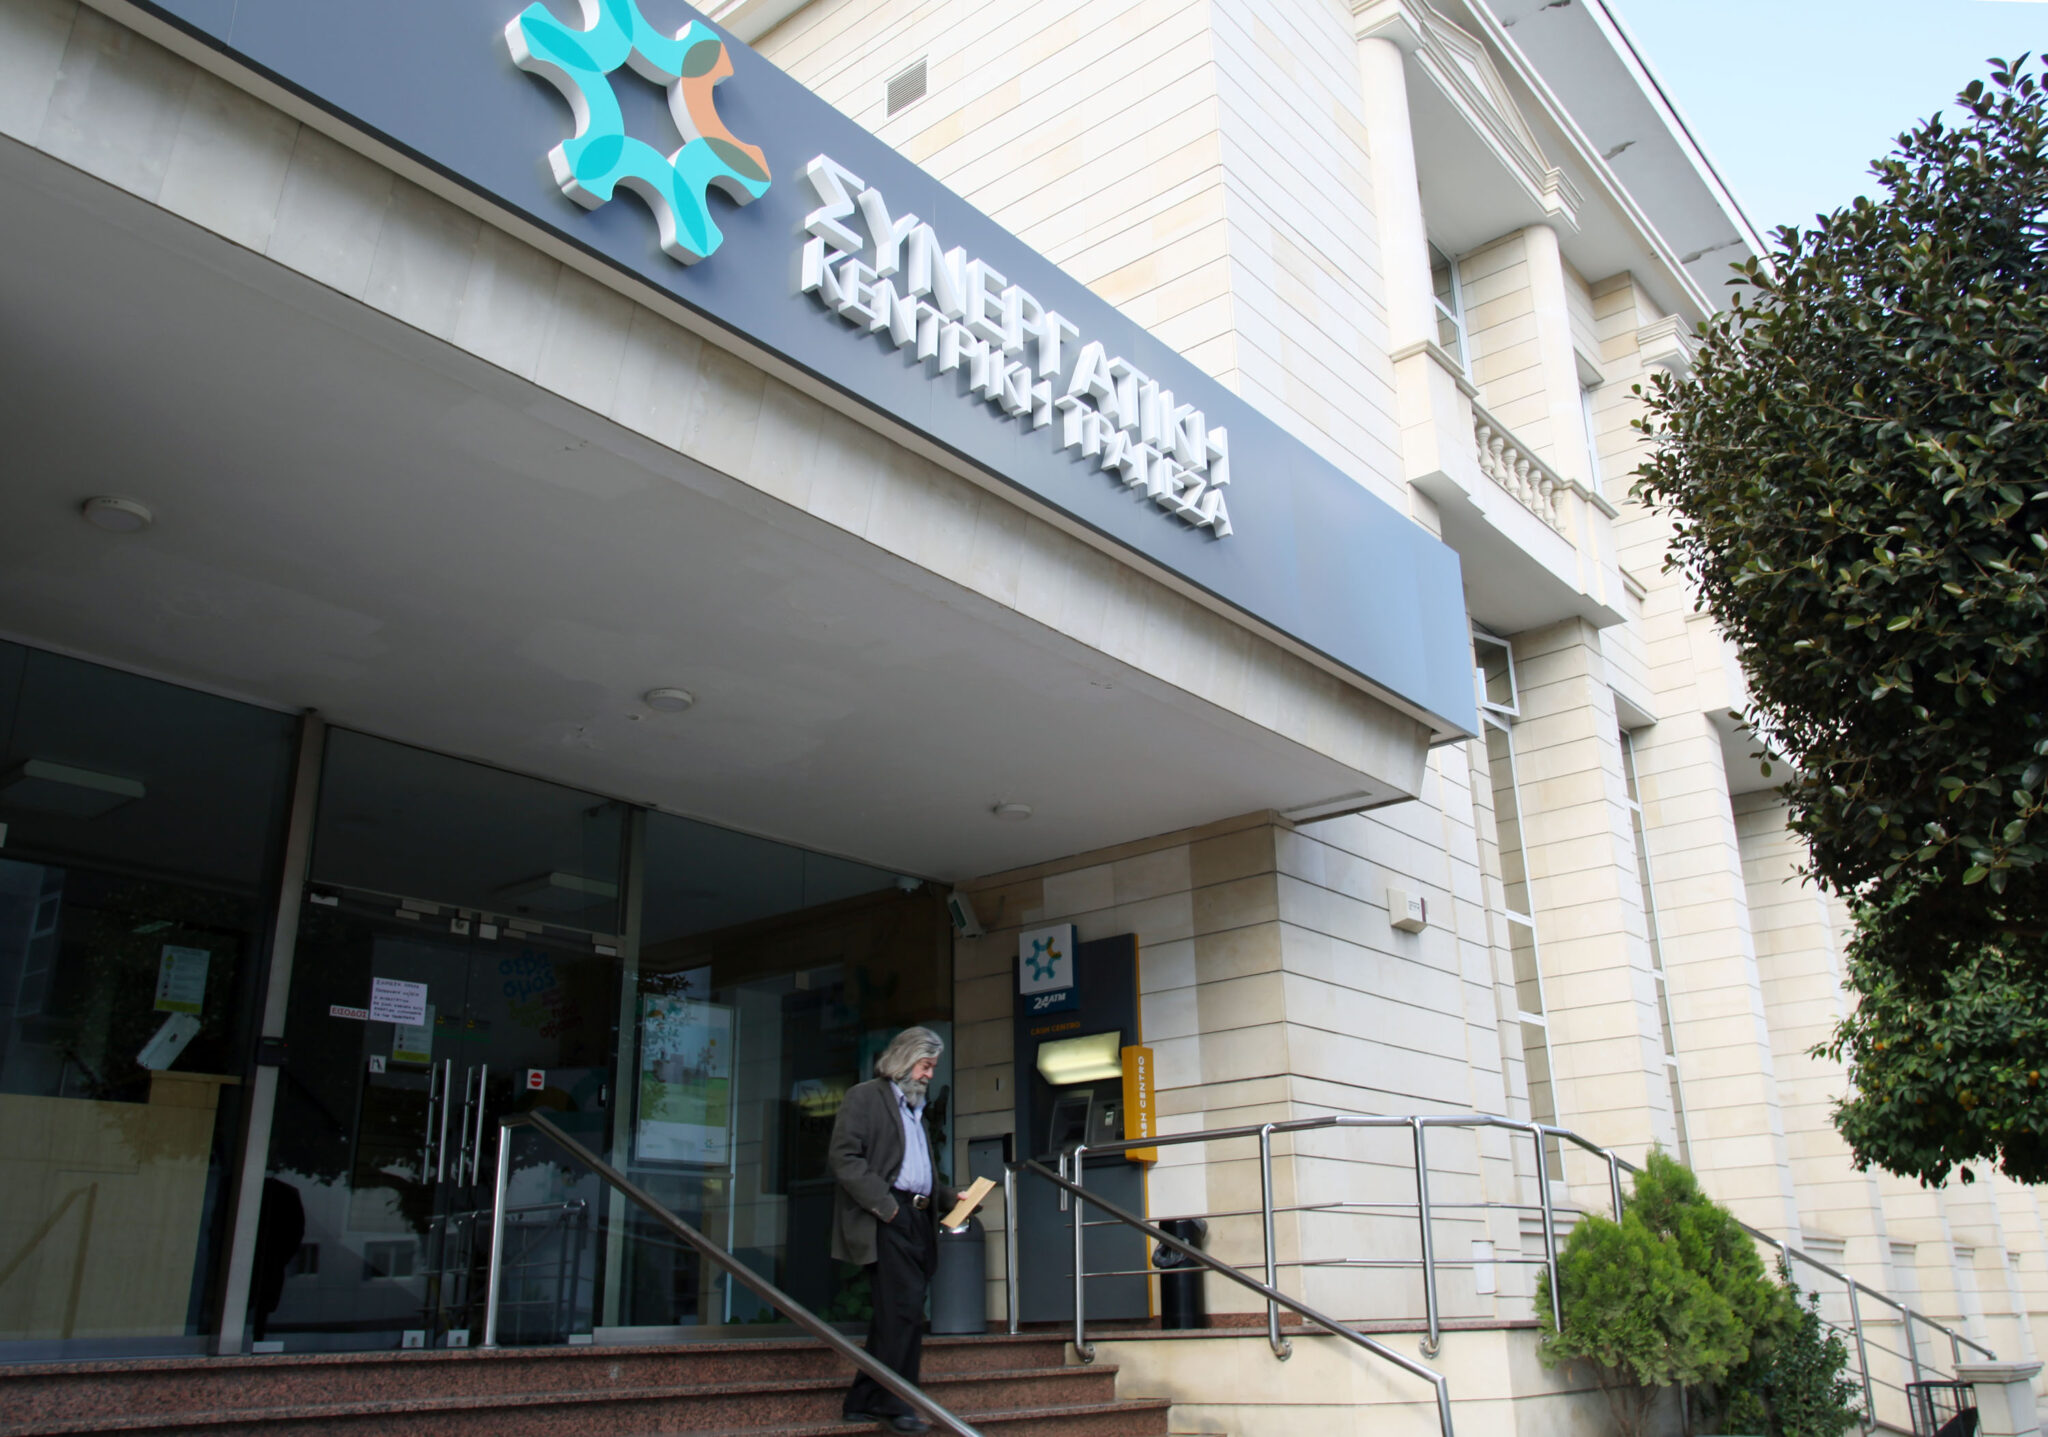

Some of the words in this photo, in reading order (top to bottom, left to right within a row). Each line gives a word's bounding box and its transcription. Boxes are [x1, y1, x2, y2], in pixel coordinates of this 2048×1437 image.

[804, 153, 1231, 489] ΣΥΝΕΡΓΑΤΙΚΗ
[801, 236, 1052, 430] ΚΕΝΤΡΙΚΗ
[1055, 394, 1234, 539] ΤΡΑΠΕΖΑ
[331, 1006, 368, 1019] ΕΙΣΟΔΟΣ
[1137, 1056, 1147, 1108] CENTRO
[1140, 1112, 1148, 1138] ASH
